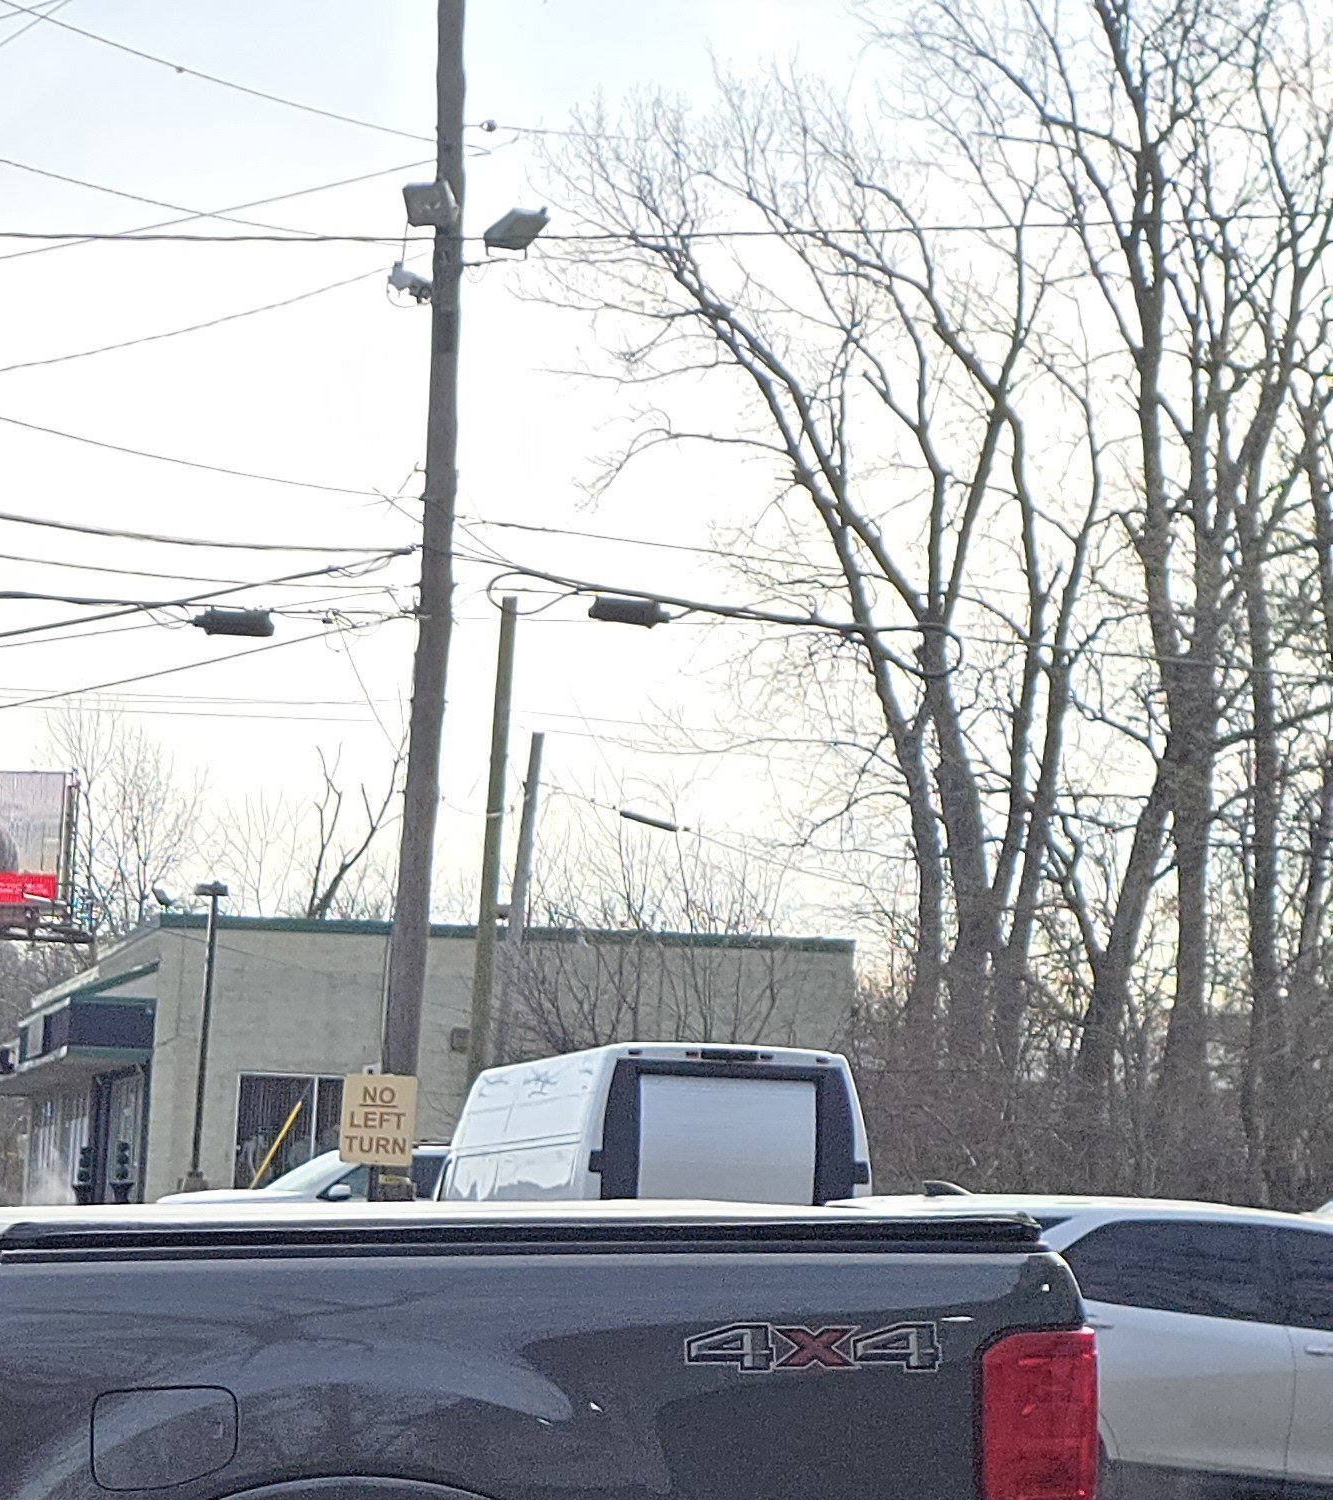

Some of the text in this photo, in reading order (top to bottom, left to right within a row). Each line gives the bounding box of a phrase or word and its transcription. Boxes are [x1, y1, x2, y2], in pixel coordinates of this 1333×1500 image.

[362, 1086, 396, 1104] NO
[349, 1110, 406, 1130] LEFT
[344, 1135, 407, 1155] TURN
